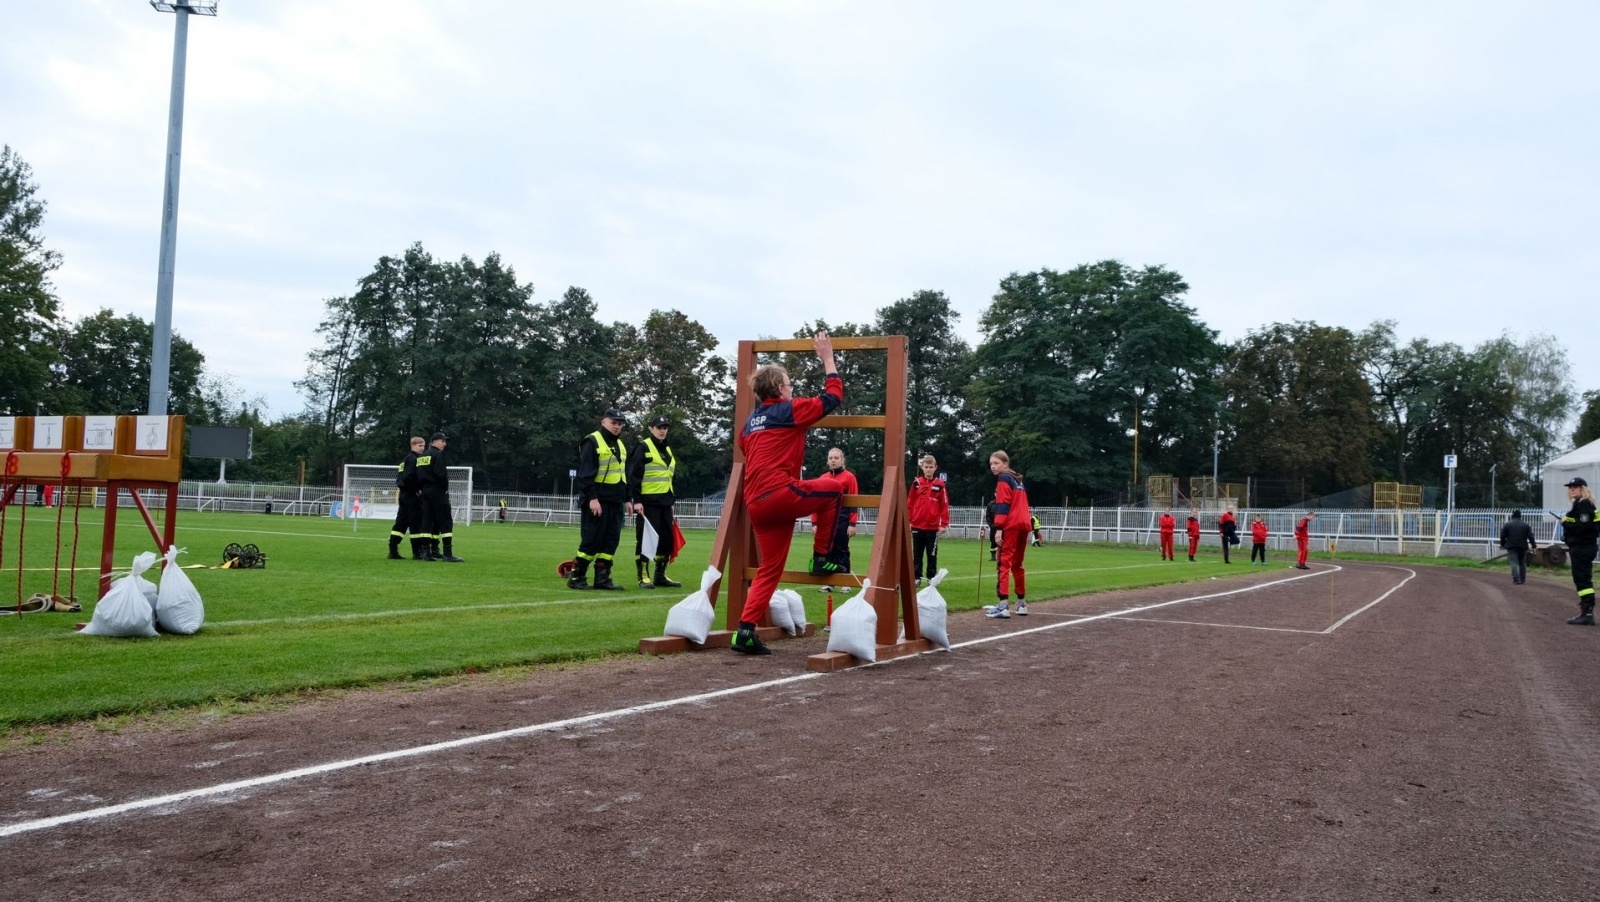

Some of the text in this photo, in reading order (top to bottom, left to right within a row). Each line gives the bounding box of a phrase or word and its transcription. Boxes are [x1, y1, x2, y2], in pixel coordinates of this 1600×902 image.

[750, 415, 767, 427] OSP
[8, 454, 19, 475] 8
[1447, 456, 1455, 467] F
